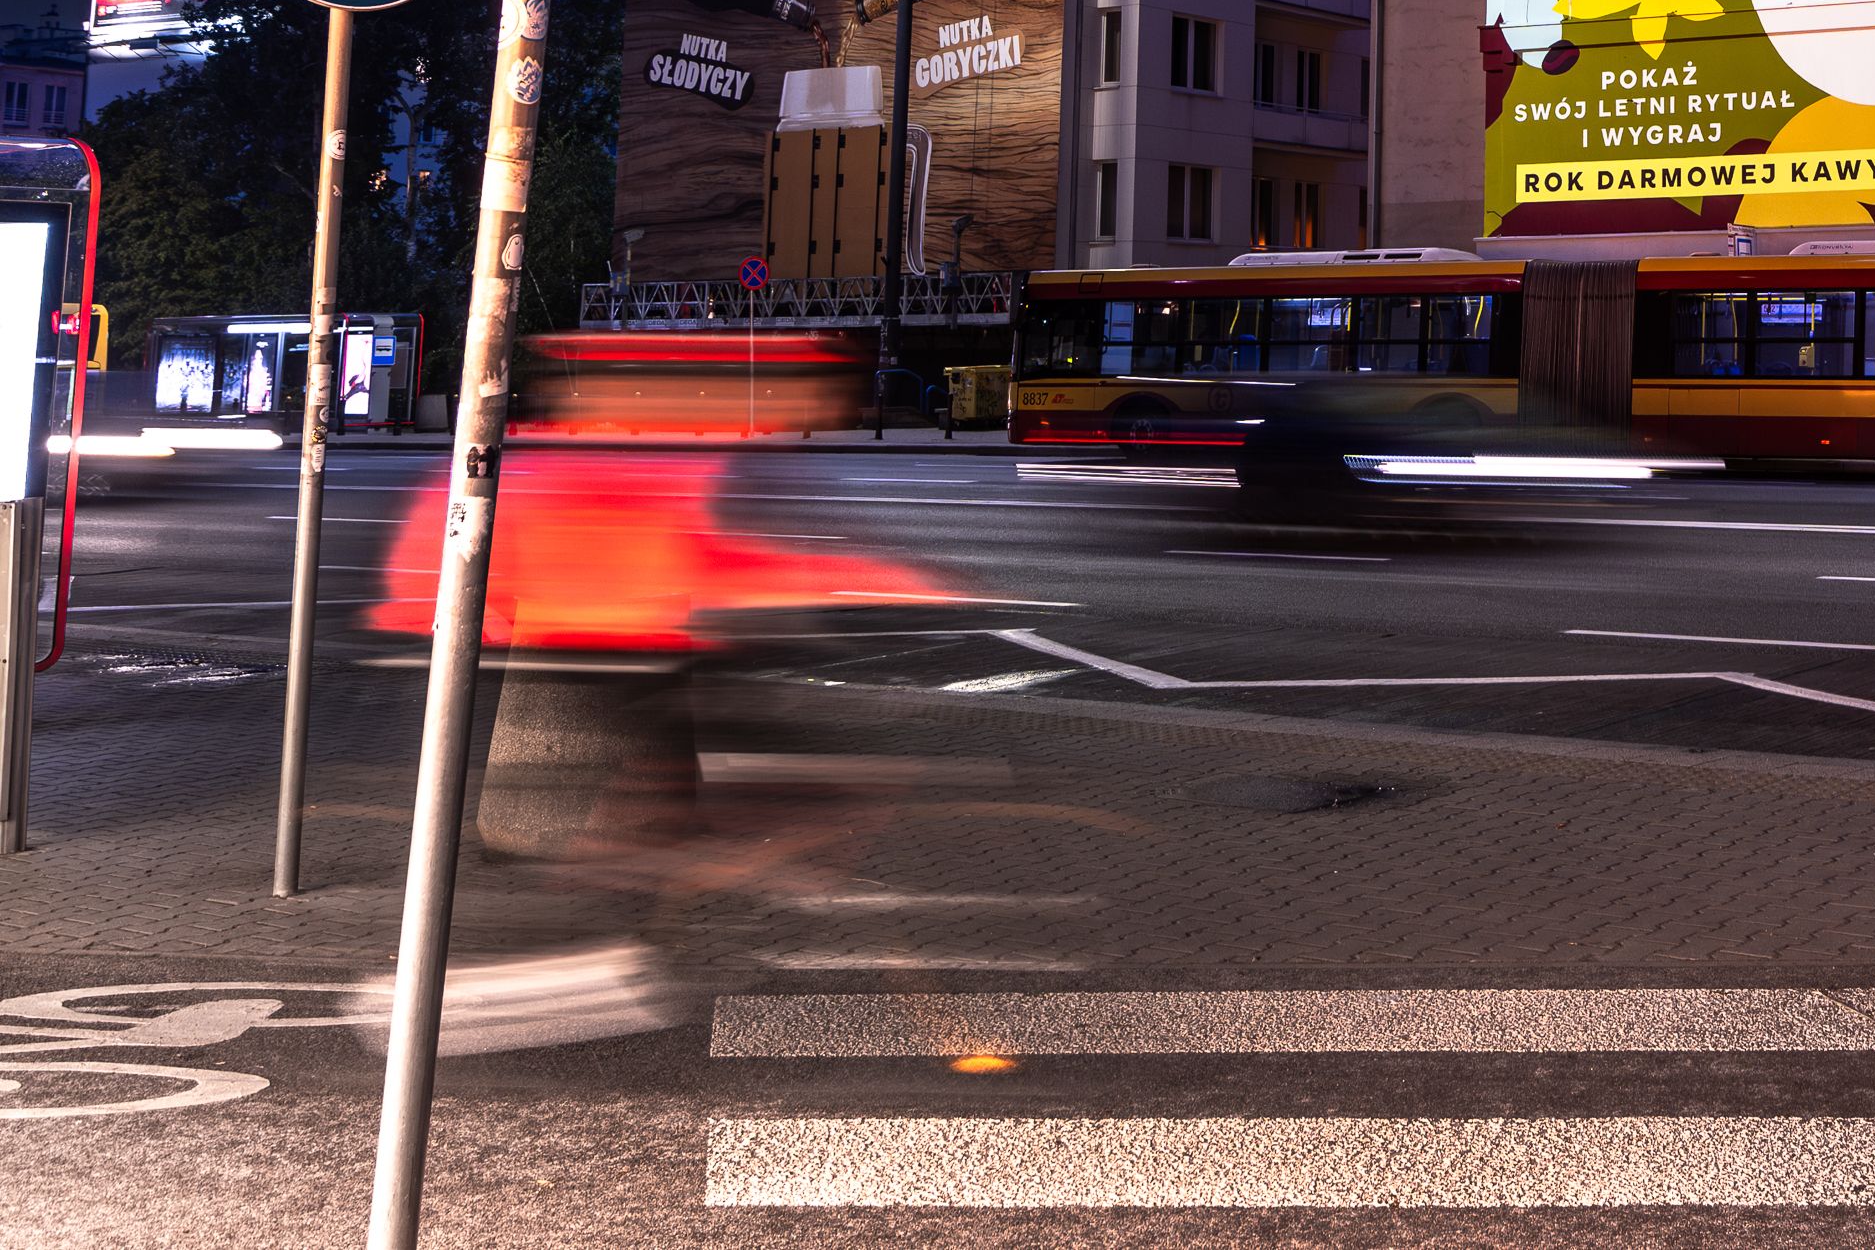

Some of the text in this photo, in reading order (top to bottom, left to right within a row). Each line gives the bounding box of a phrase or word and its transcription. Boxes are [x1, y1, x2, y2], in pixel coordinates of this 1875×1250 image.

[680, 33, 727, 62] NUTKA
[938, 16, 993, 49] NUTKA
[915, 34, 1021, 88] GORYCZKI
[1601, 60, 1698, 91] POKAŻ
[649, 53, 751, 105] SŁODYCZY
[1514, 89, 1795, 123] SWÓJ LETNI RYTUAŁ
[1582, 122, 1722, 148] I WYGRAJ
[1524, 171, 1584, 194] ROK
[1598, 163, 1777, 190] DARMOWEJ
[1022, 392, 1049, 406] 8837
